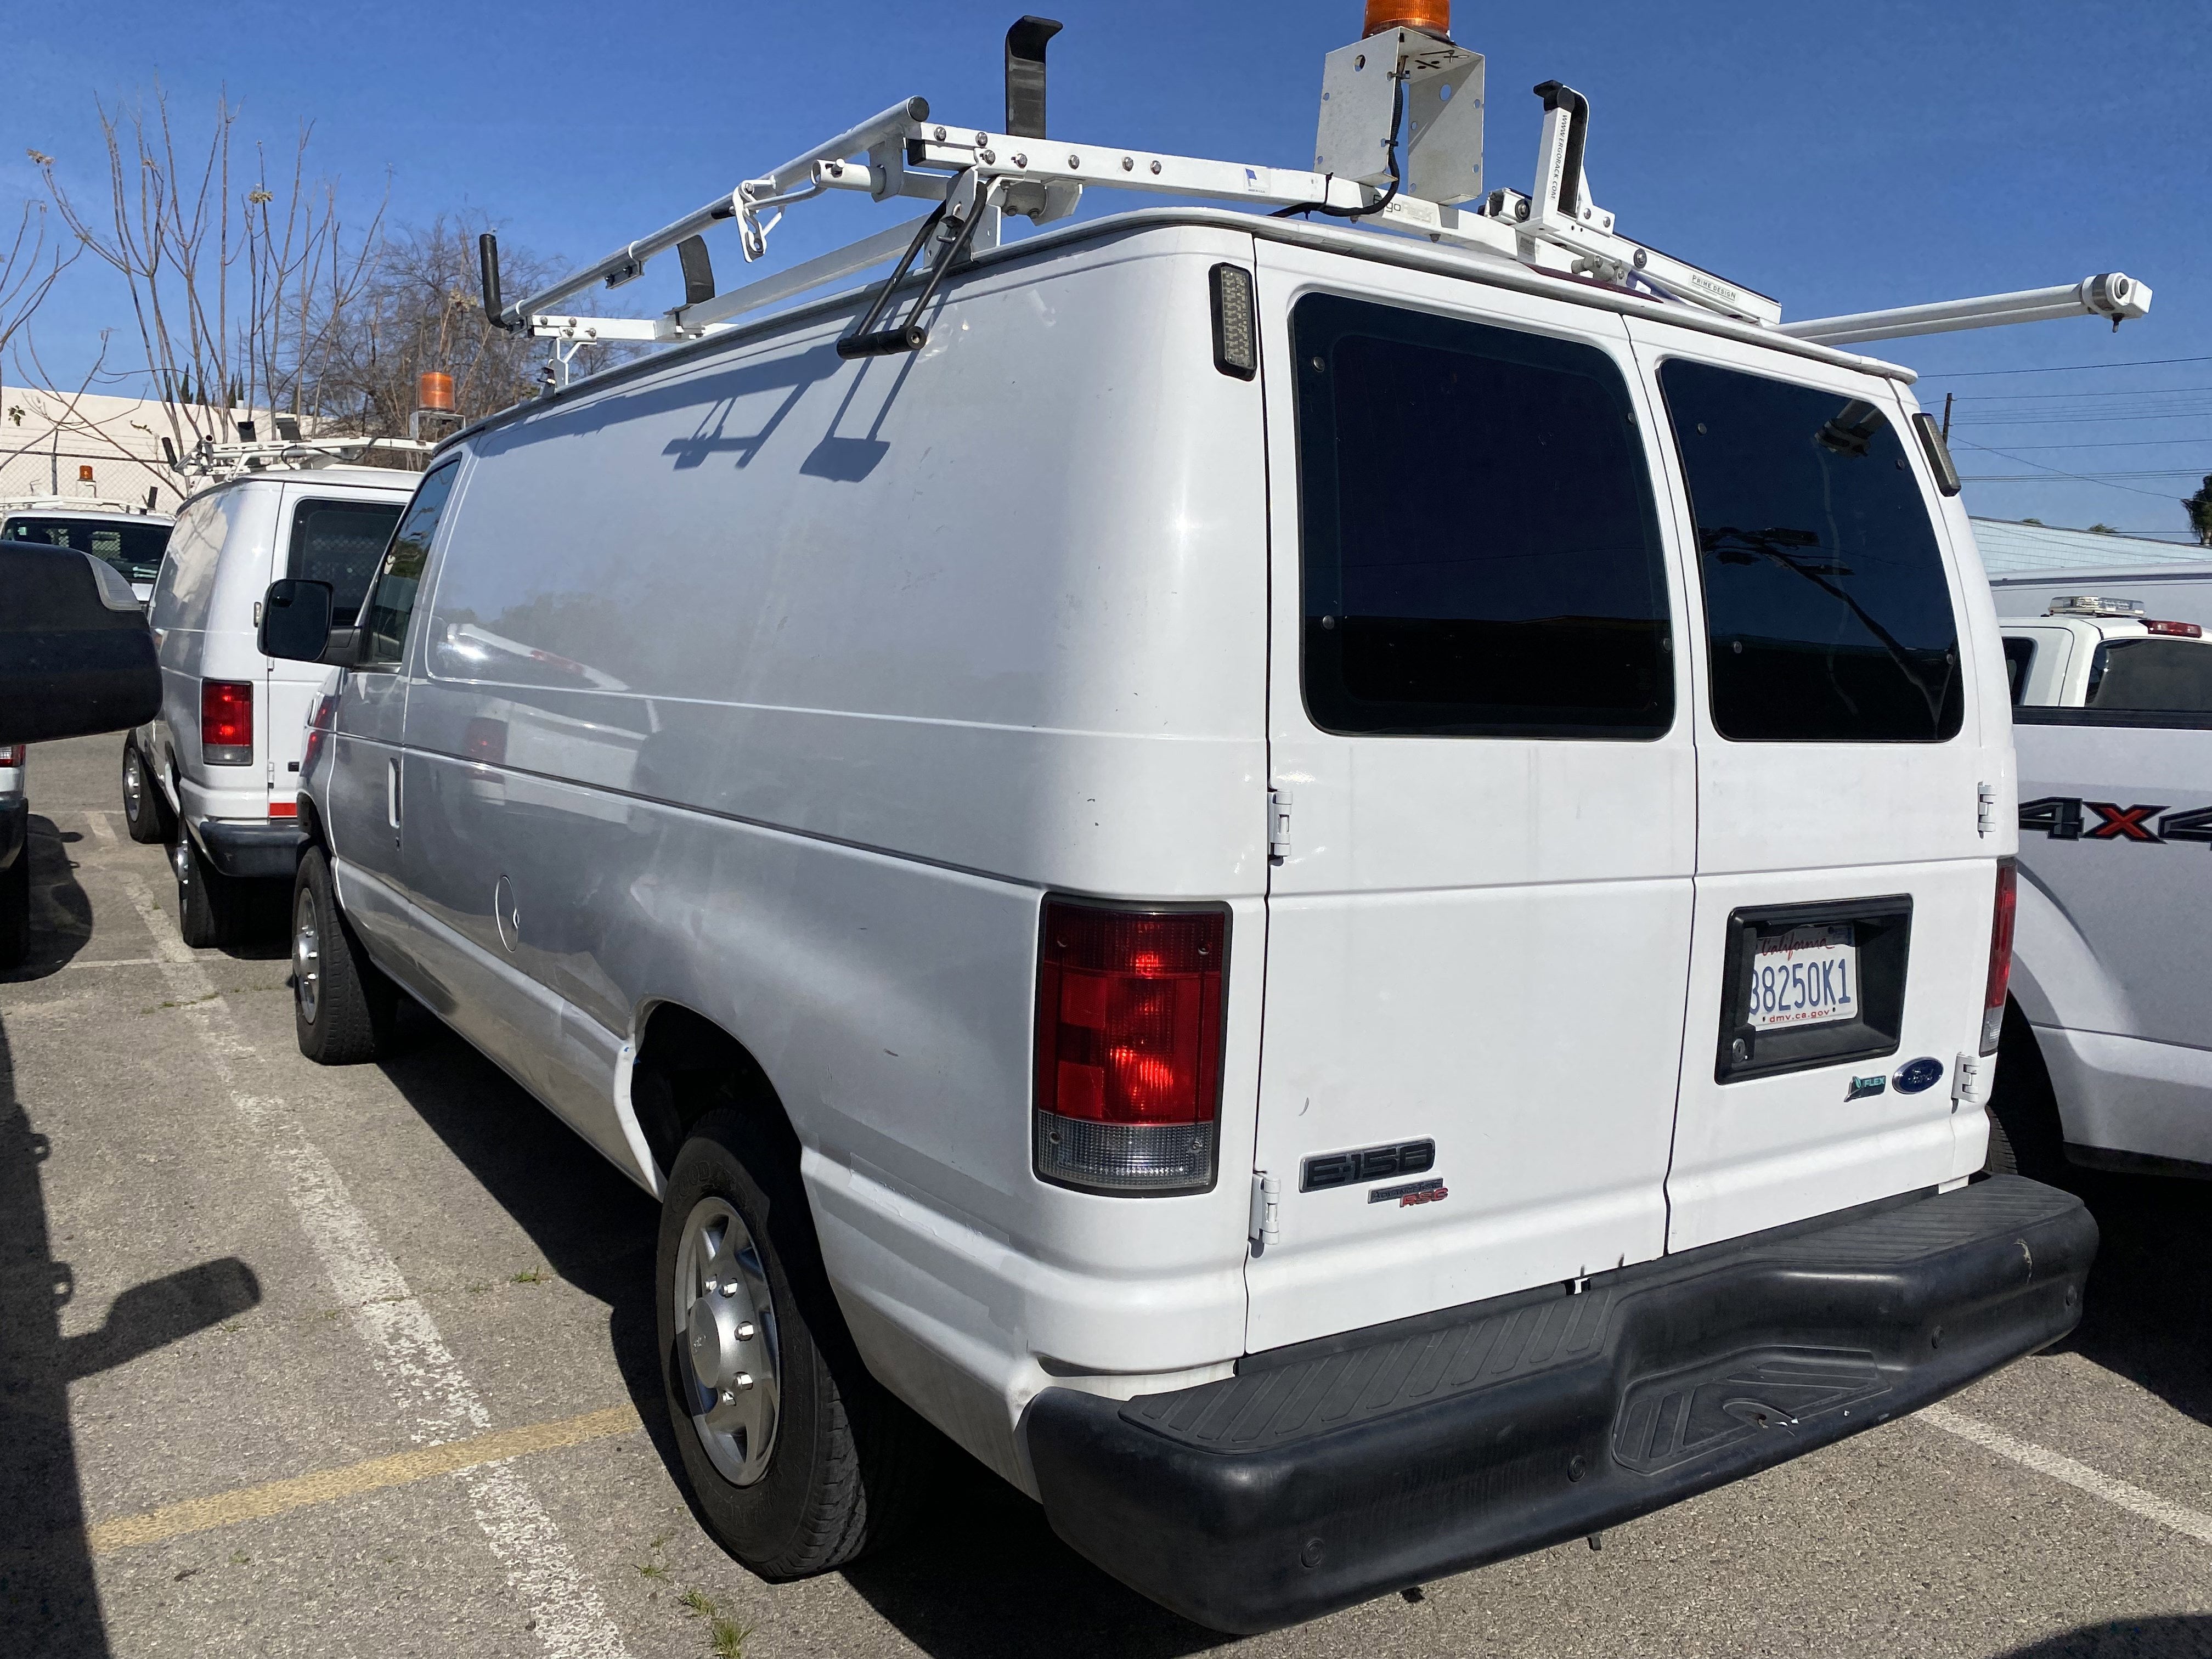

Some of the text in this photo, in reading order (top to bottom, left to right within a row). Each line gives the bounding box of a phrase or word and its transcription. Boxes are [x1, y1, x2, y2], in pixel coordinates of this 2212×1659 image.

[1692, 275, 1712, 289] PRIME
[1713, 285, 1736, 299] DESIGN
[1762, 932, 1836, 961] California
[1749, 959, 1851, 1015] 38250K1
[1769, 1009, 1830, 1023] dmv.ca.gov
[1864, 1077, 1885, 1088] FLEX
[1306, 1142, 1433, 1187] E-150
[1401, 1187, 1448, 1207] RSC
